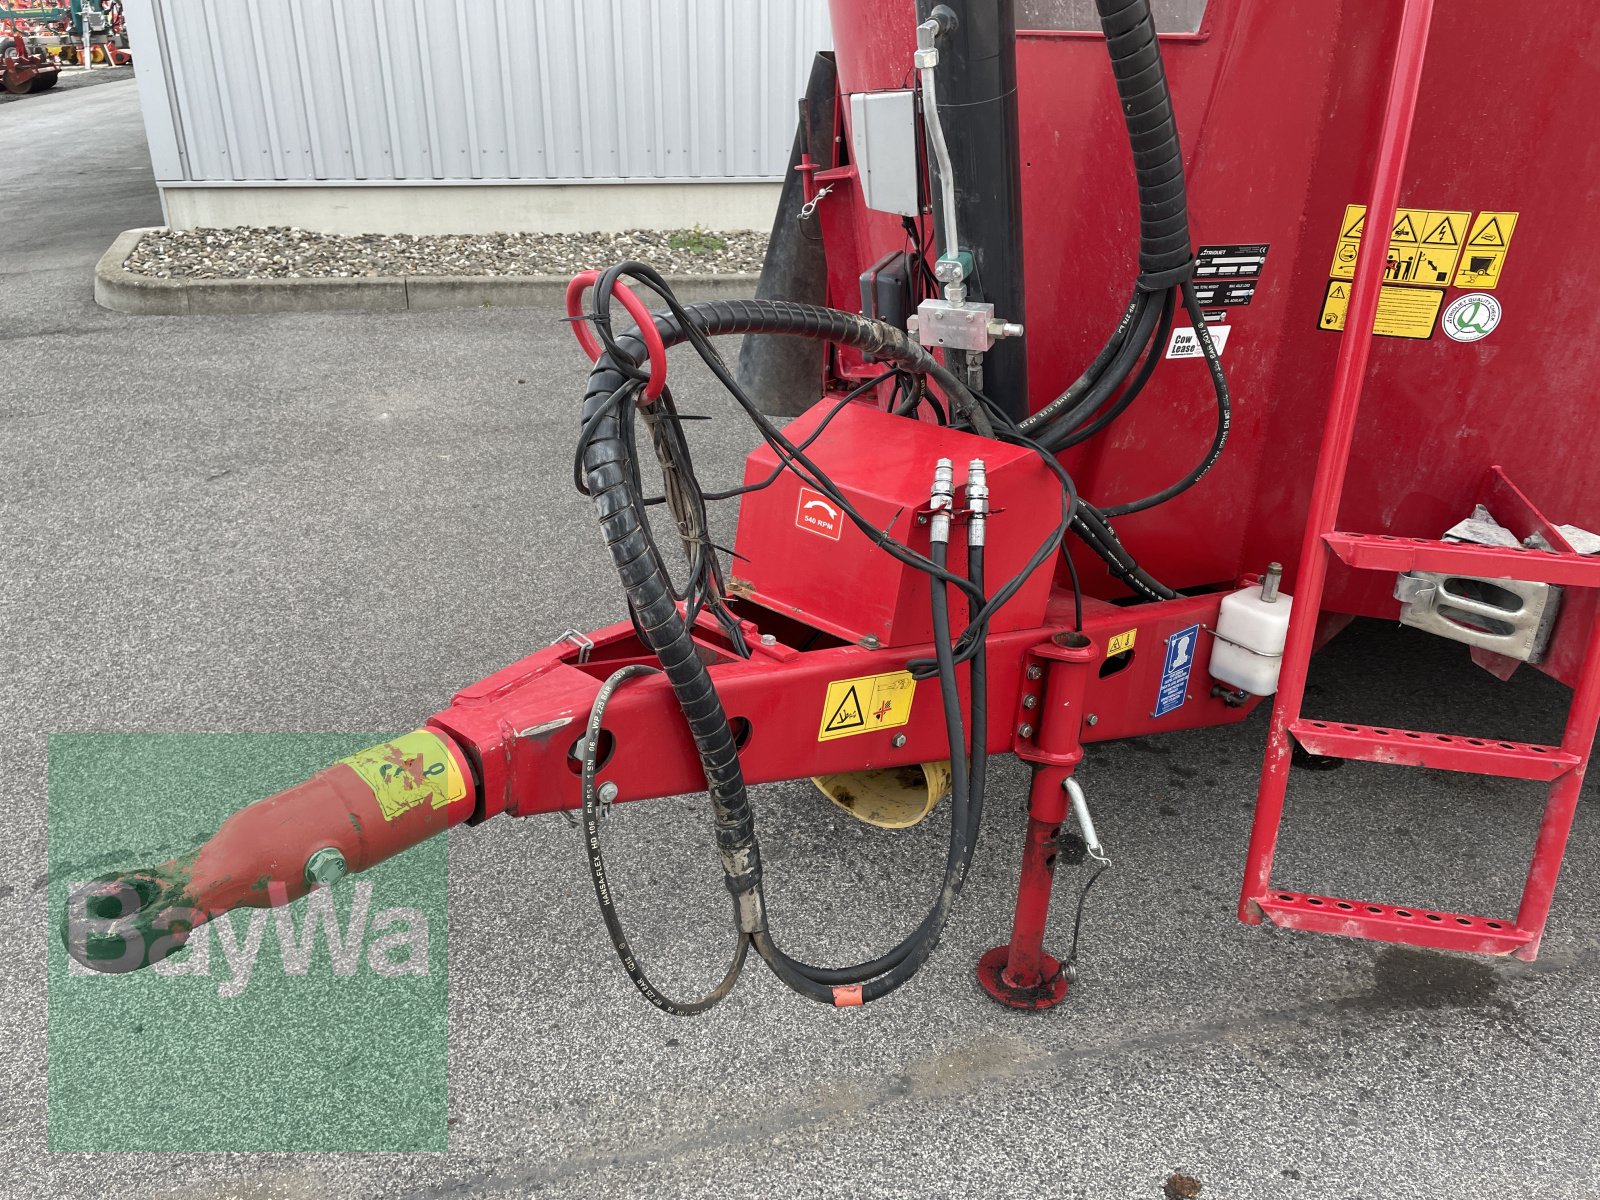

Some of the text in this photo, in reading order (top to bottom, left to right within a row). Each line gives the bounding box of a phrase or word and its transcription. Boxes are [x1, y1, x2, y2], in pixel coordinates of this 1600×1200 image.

[1174, 334, 1193, 344] Cow
[1171, 344, 1196, 354] Lease
[804, 515, 834, 530] 540 RPM
[601, 685, 612, 700] BAR
[592, 716, 600, 729] WP
[588, 741, 596, 752] 06
[586, 760, 594, 772] SN
[587, 802, 593, 814] EN
[590, 837, 598, 850] HD
[593, 855, 611, 906] HANSA-FLEX
